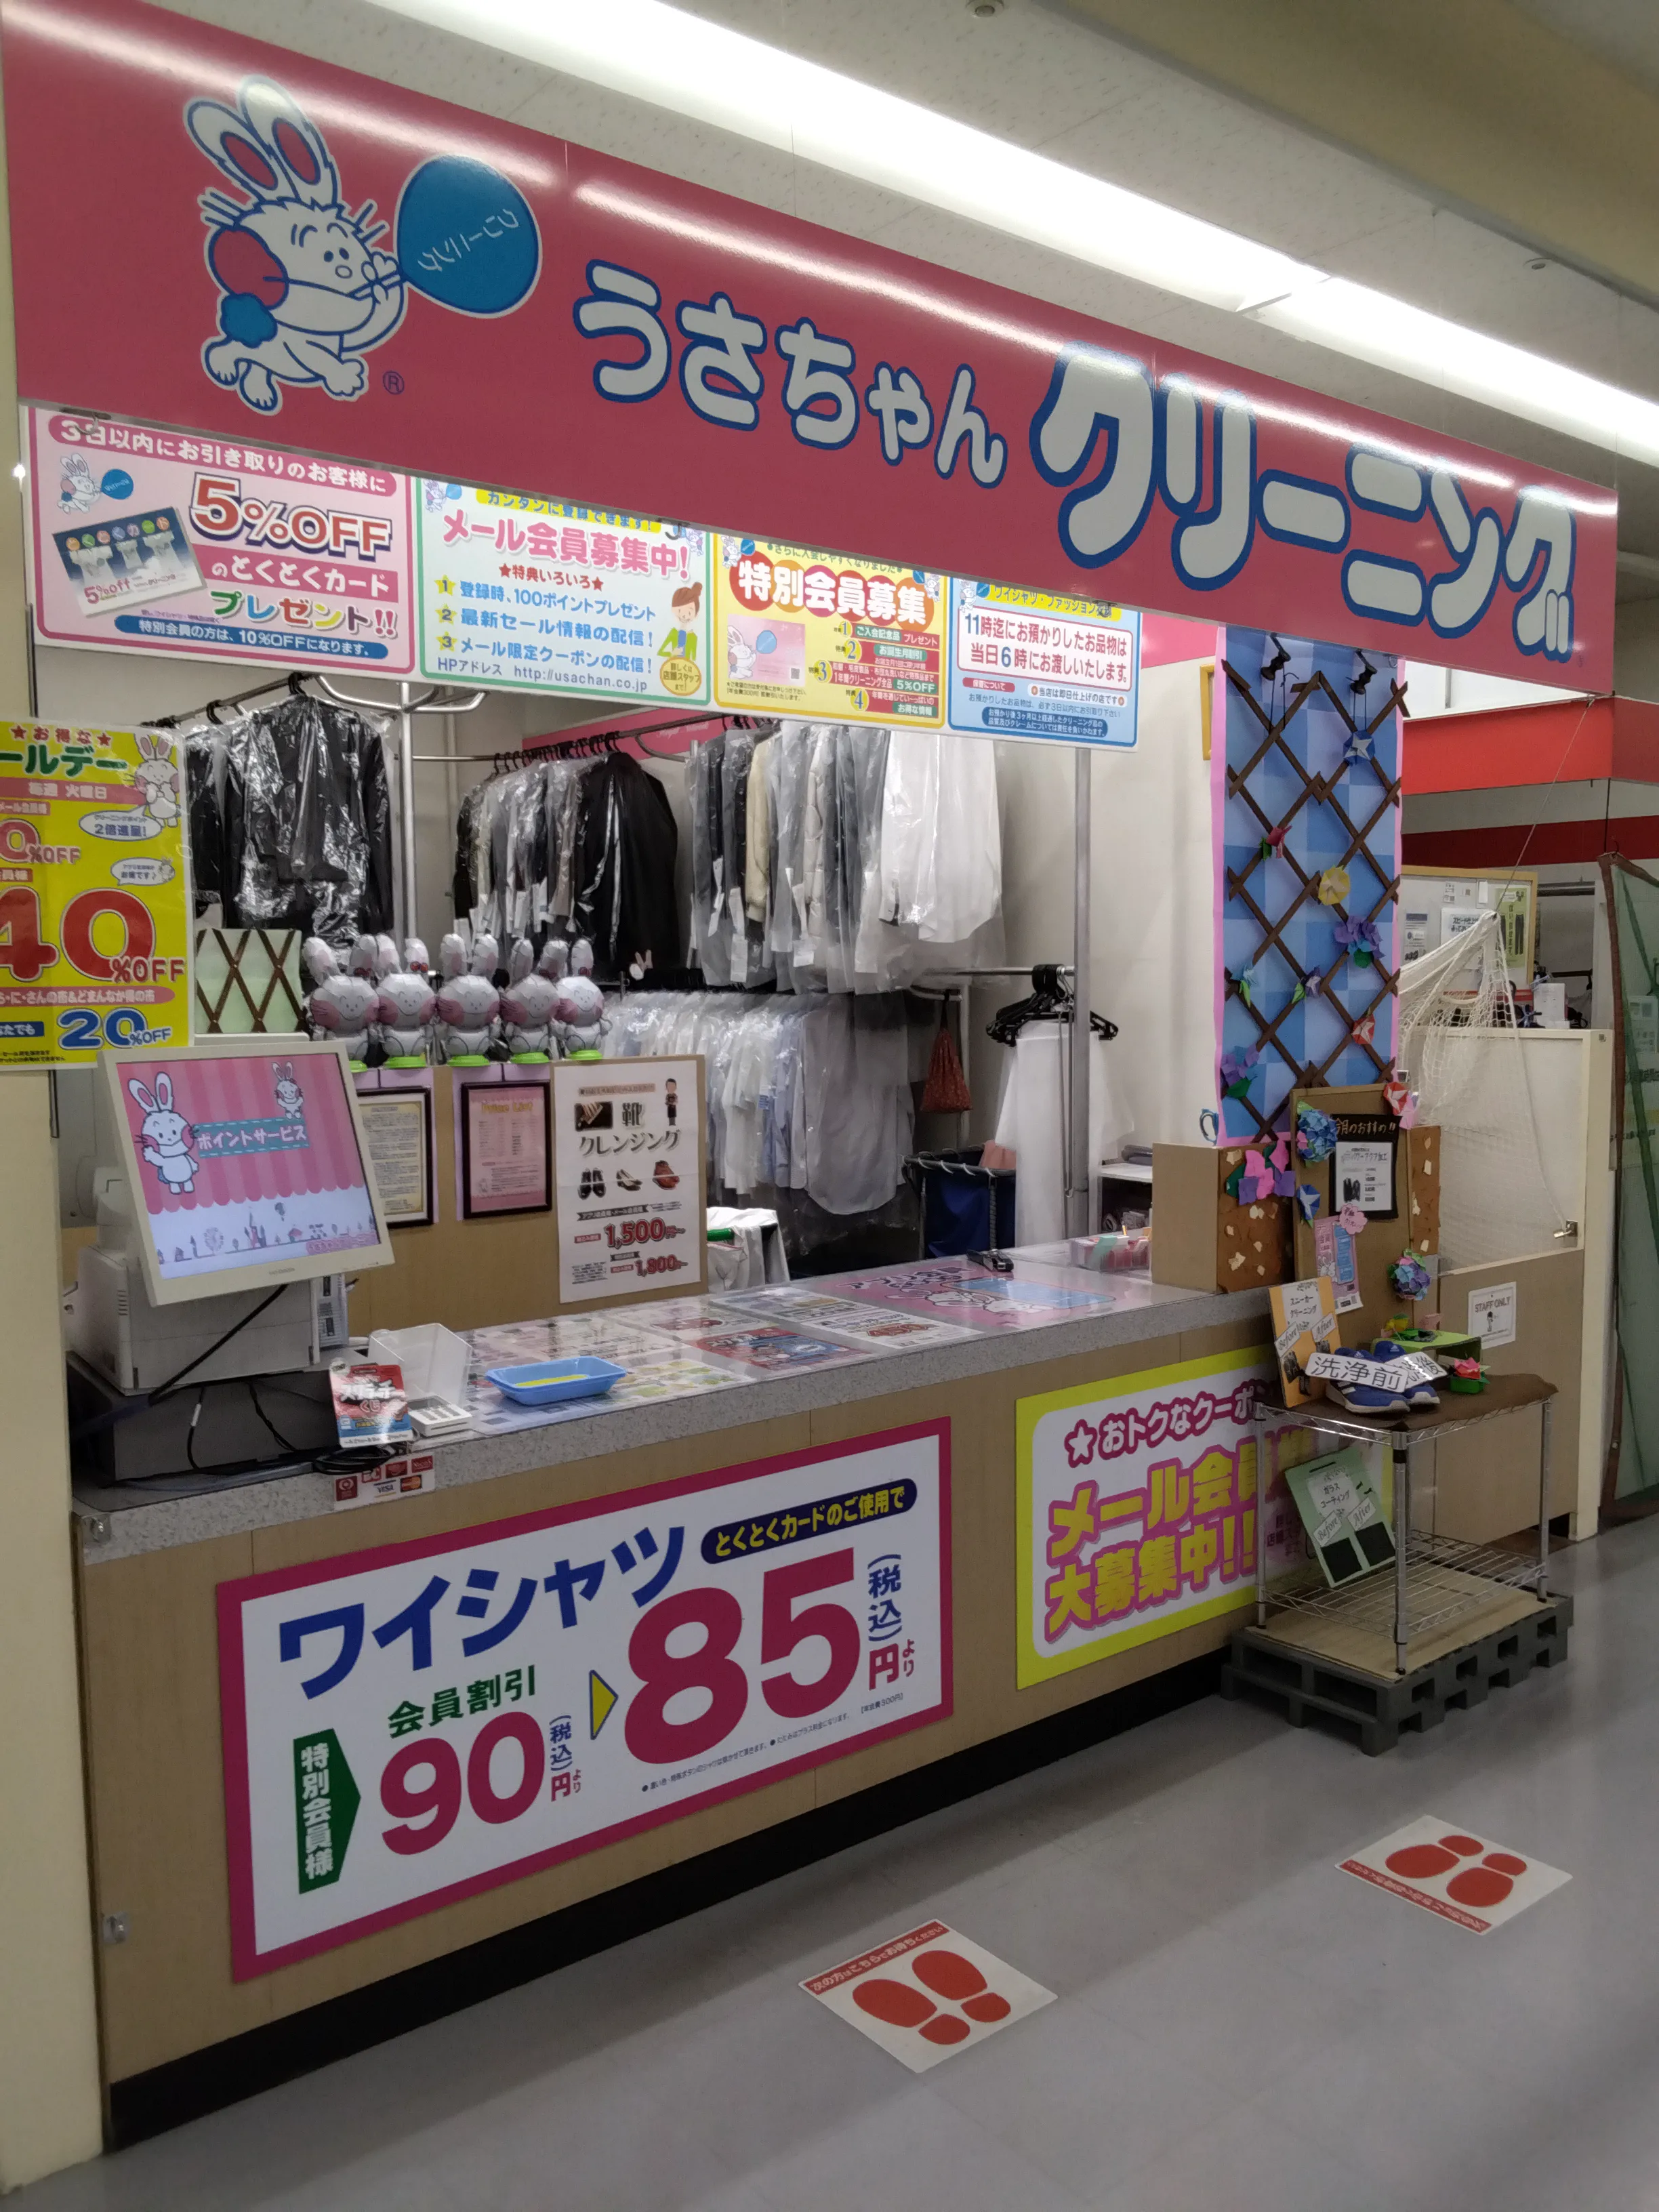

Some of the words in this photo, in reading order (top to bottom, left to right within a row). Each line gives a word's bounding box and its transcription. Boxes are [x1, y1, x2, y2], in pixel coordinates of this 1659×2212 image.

[61, 420, 388, 494] 3日以内にお引き取りのお客様に
[190, 472, 392, 561] 5%OFF
[443, 509, 689, 579] メール会員募集中!
[212, 556, 390, 599] のとくとくカード
[738, 561, 926, 624] 特別会員募集
[443, 580, 448, 591] 1
[460, 581, 656, 621] 登録時、100ポイントプレゼント
[442, 610, 452, 621] 2
[461, 609, 653, 648] 最新セール情報の配信!
[903, 634, 938, 646] プレゼント
[965, 613, 1127, 656] 11時迄にお預かりしたお品物は
[442, 636, 452, 647] 3
[461, 638, 652, 673] メール限定クーポンの配信!
[847, 640, 856, 659] 2
[971, 643, 1127, 682] 当日6時にお渡しいたします。
[437, 657, 502, 676] HPアドレス
[514, 666, 647, 692] http://usachan.co.jp
[818, 662, 827, 681] 3
[854, 691, 863, 710] 4
[199, 1126, 306, 1149] ポイントサービス
[579, 1129, 681, 1156] クレンジング
[605, 1218, 665, 1249] 1,500
[1475, 1300, 1494, 1313] STAFF
[1494, 1296, 1511, 1307] ONLY
[1311, 1355, 1406, 1391] 洗浄前
[1100, 1384, 1265, 1454] おトクなクーポ
[716, 1485, 905, 1557] とくとくカードのご使用で
[279, 1526, 684, 1700] ワイシャツ
[625, 1547, 860, 1764] 85
[869, 1643, 899, 1691] 円
[388, 1664, 535, 1739] 会員割引
[380, 1711, 545, 1856] 90
[551, 1771, 571, 1801] 円
[300, 1742, 333, 1881] 特別会員様
